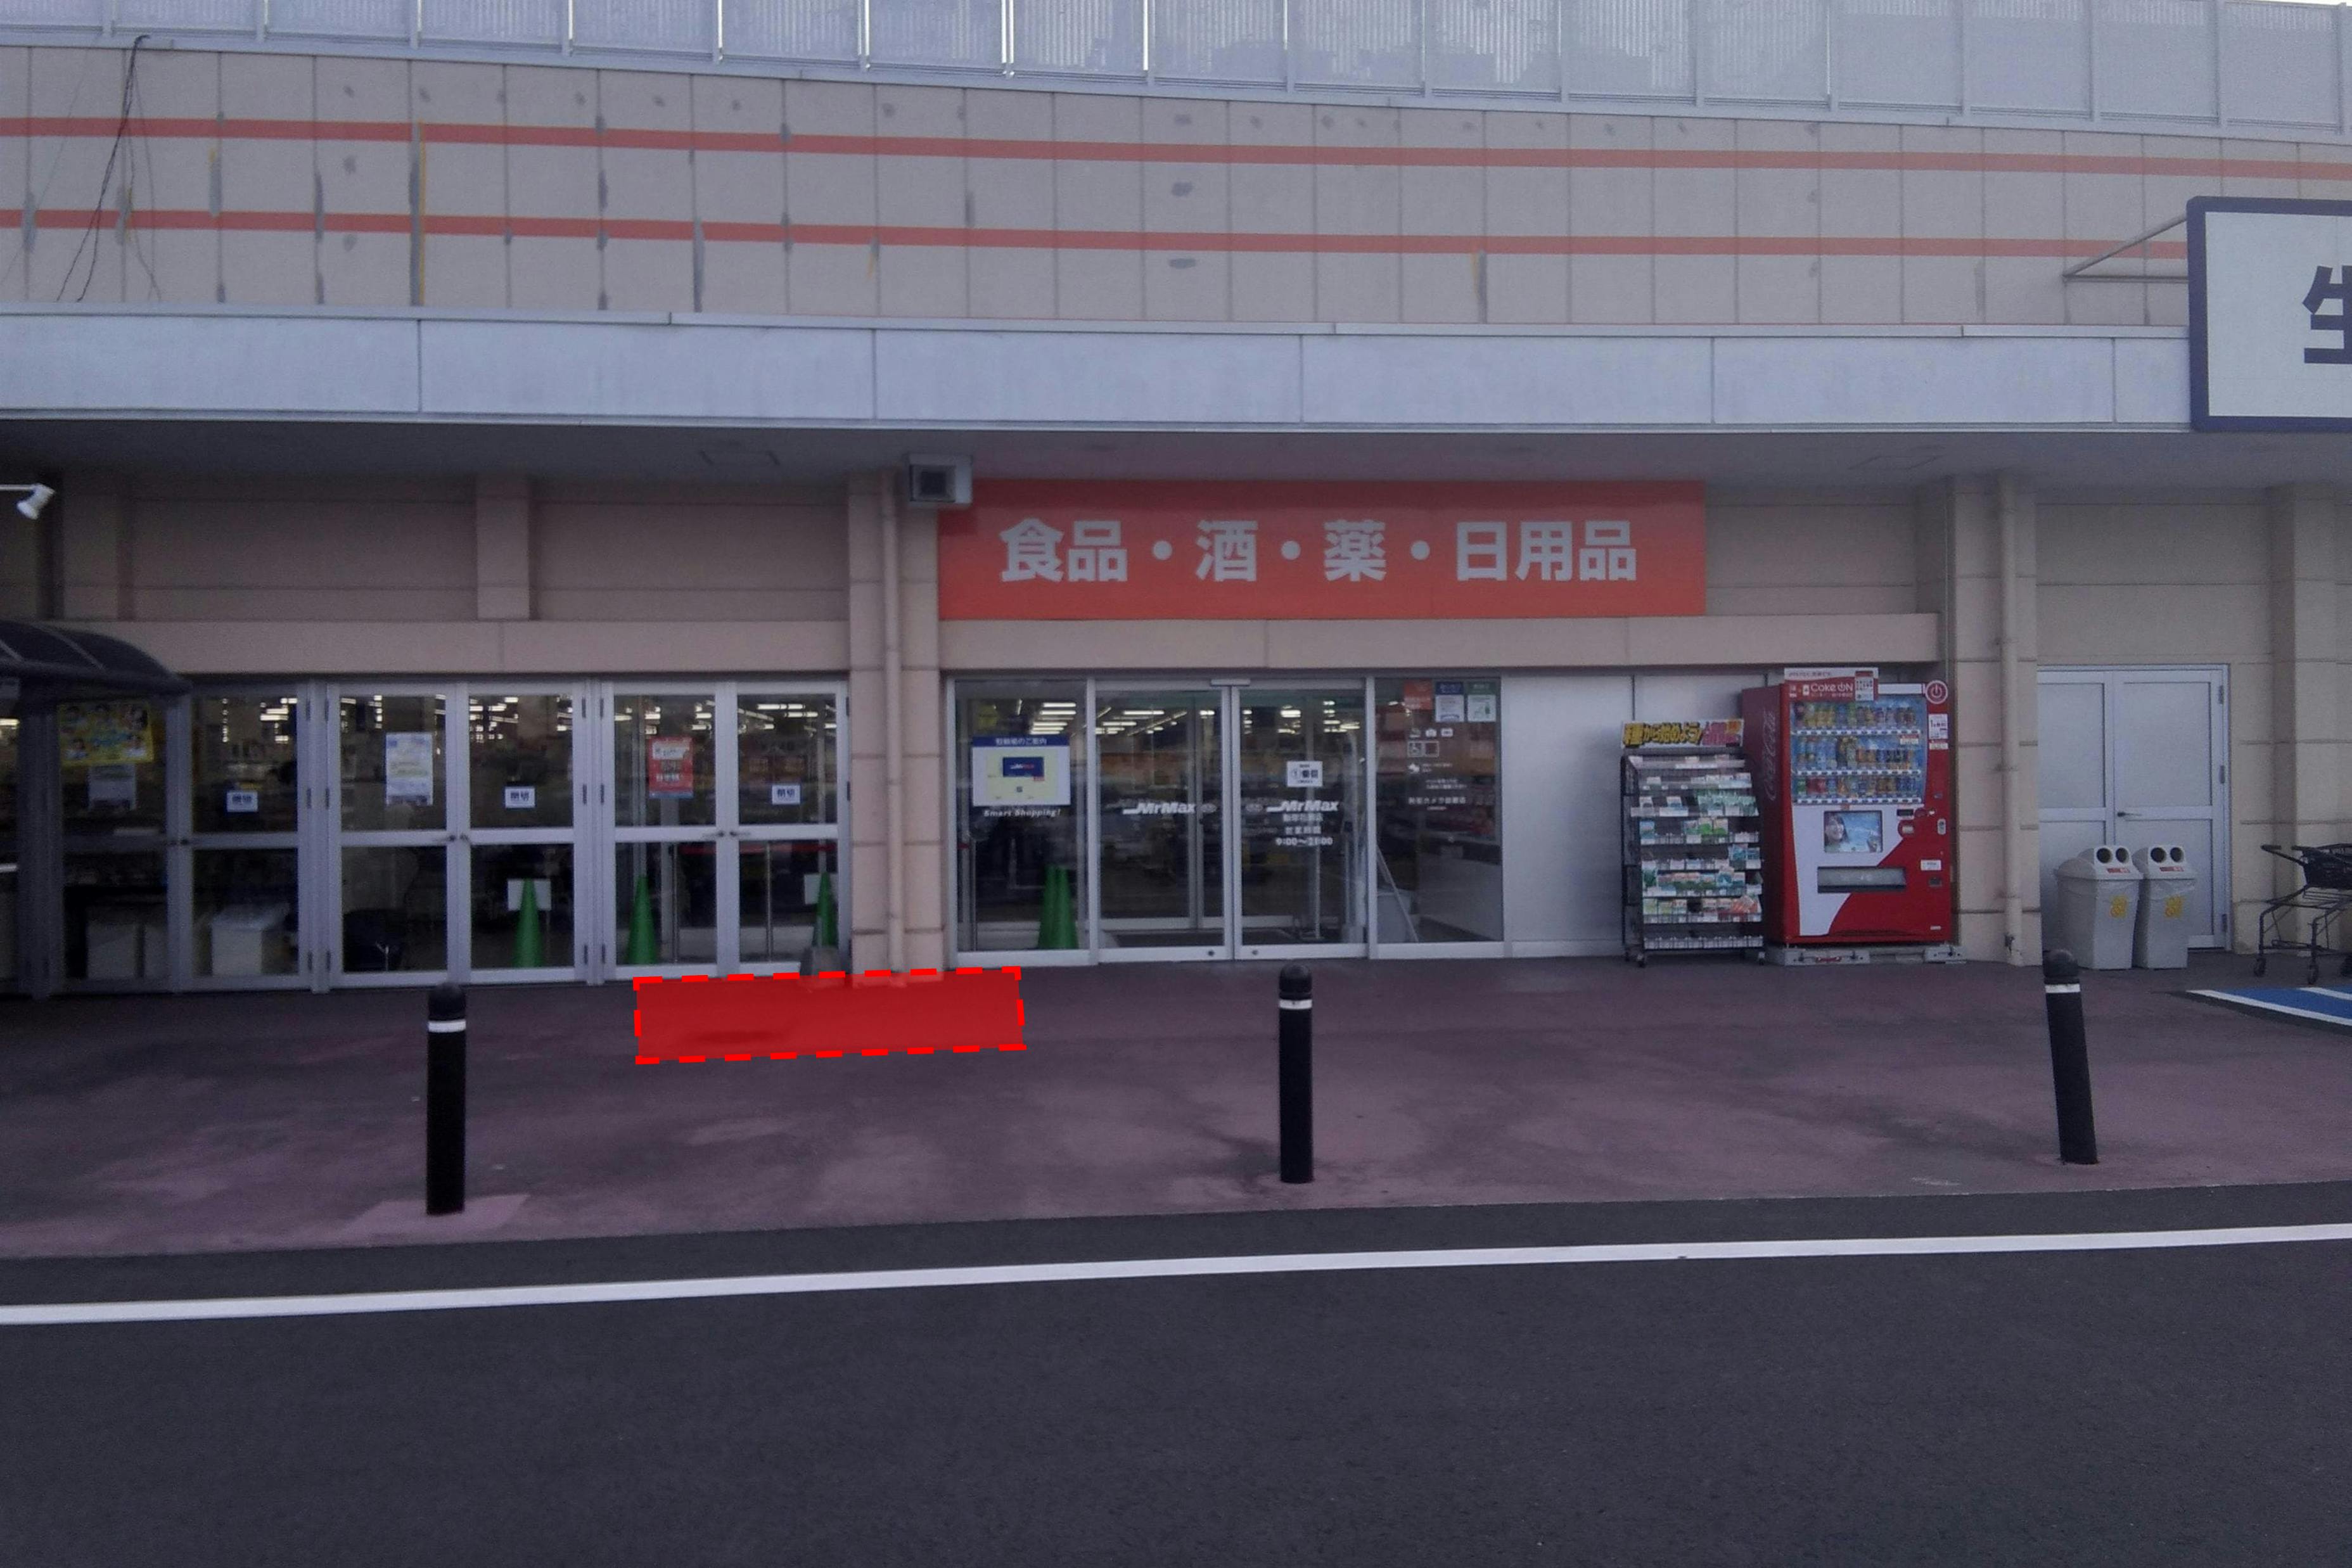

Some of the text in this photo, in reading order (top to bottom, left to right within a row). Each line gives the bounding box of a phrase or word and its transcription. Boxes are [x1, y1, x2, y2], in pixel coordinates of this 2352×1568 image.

[999, 518, 1637, 583] 食品・酒・薬・日用品
[1810, 683, 1837, 692] Coke
[1132, 801, 1196, 815] MrMax
[1275, 800, 1339, 812] MrMax
